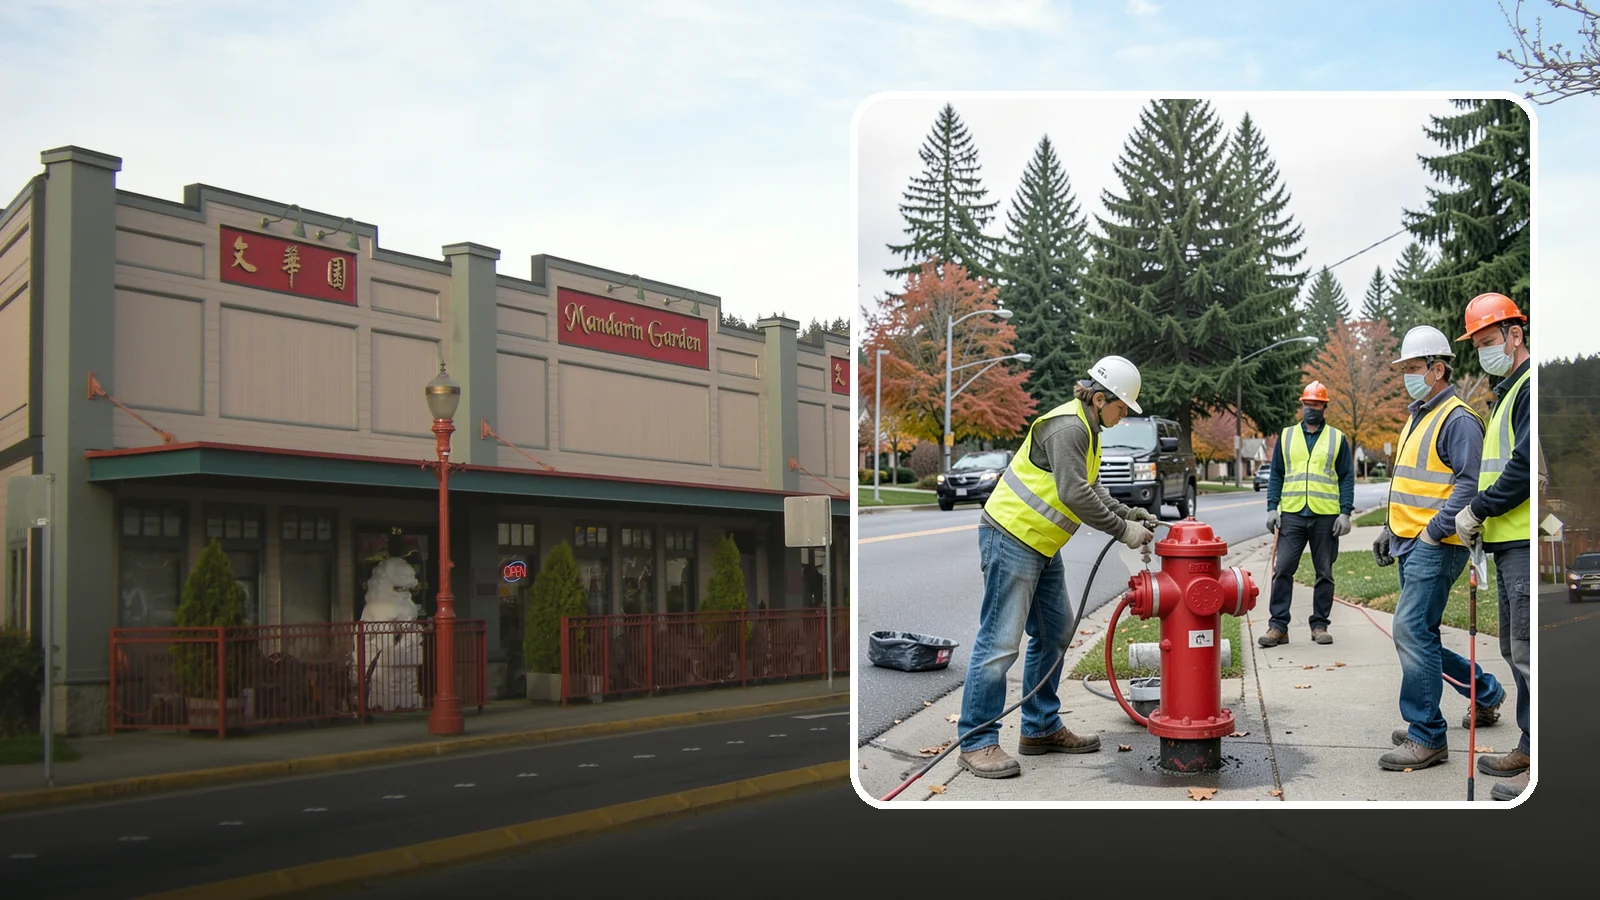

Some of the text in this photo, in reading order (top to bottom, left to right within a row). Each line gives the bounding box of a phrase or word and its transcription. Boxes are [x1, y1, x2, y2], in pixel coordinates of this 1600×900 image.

[564, 302, 701, 352] Mandarin Garden
[503, 565, 527, 578] OPEN
